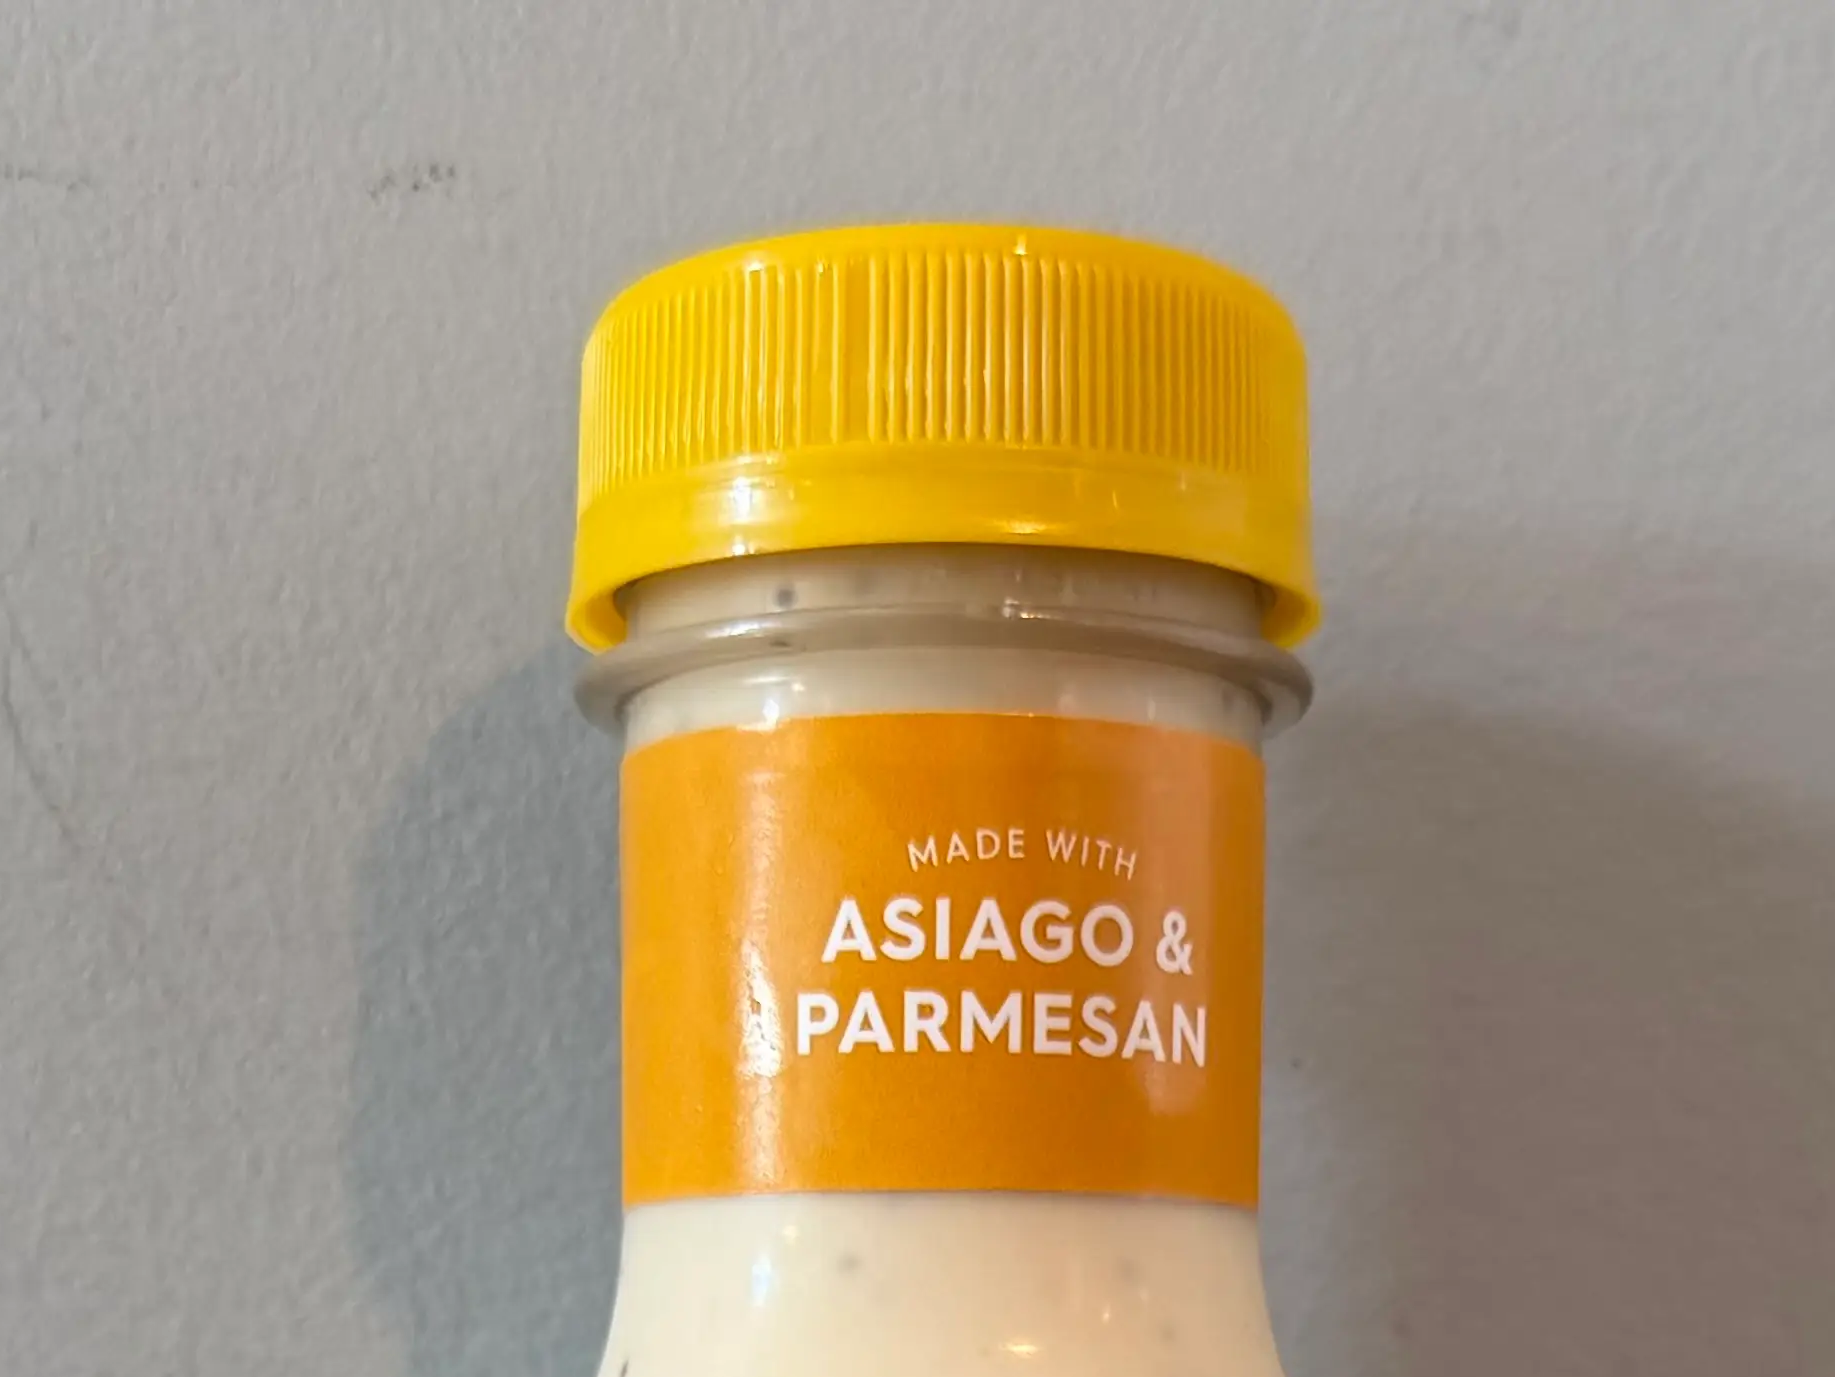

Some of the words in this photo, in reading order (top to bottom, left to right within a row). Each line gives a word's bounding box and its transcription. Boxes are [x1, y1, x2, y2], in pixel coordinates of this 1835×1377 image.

[907, 829, 1025, 872] MADE
[1046, 830, 1137, 880] WITH
[821, 896, 1134, 966] ASIAGO
[1155, 910, 1192, 975] &
[796, 990, 1206, 1068] PARMESAN
